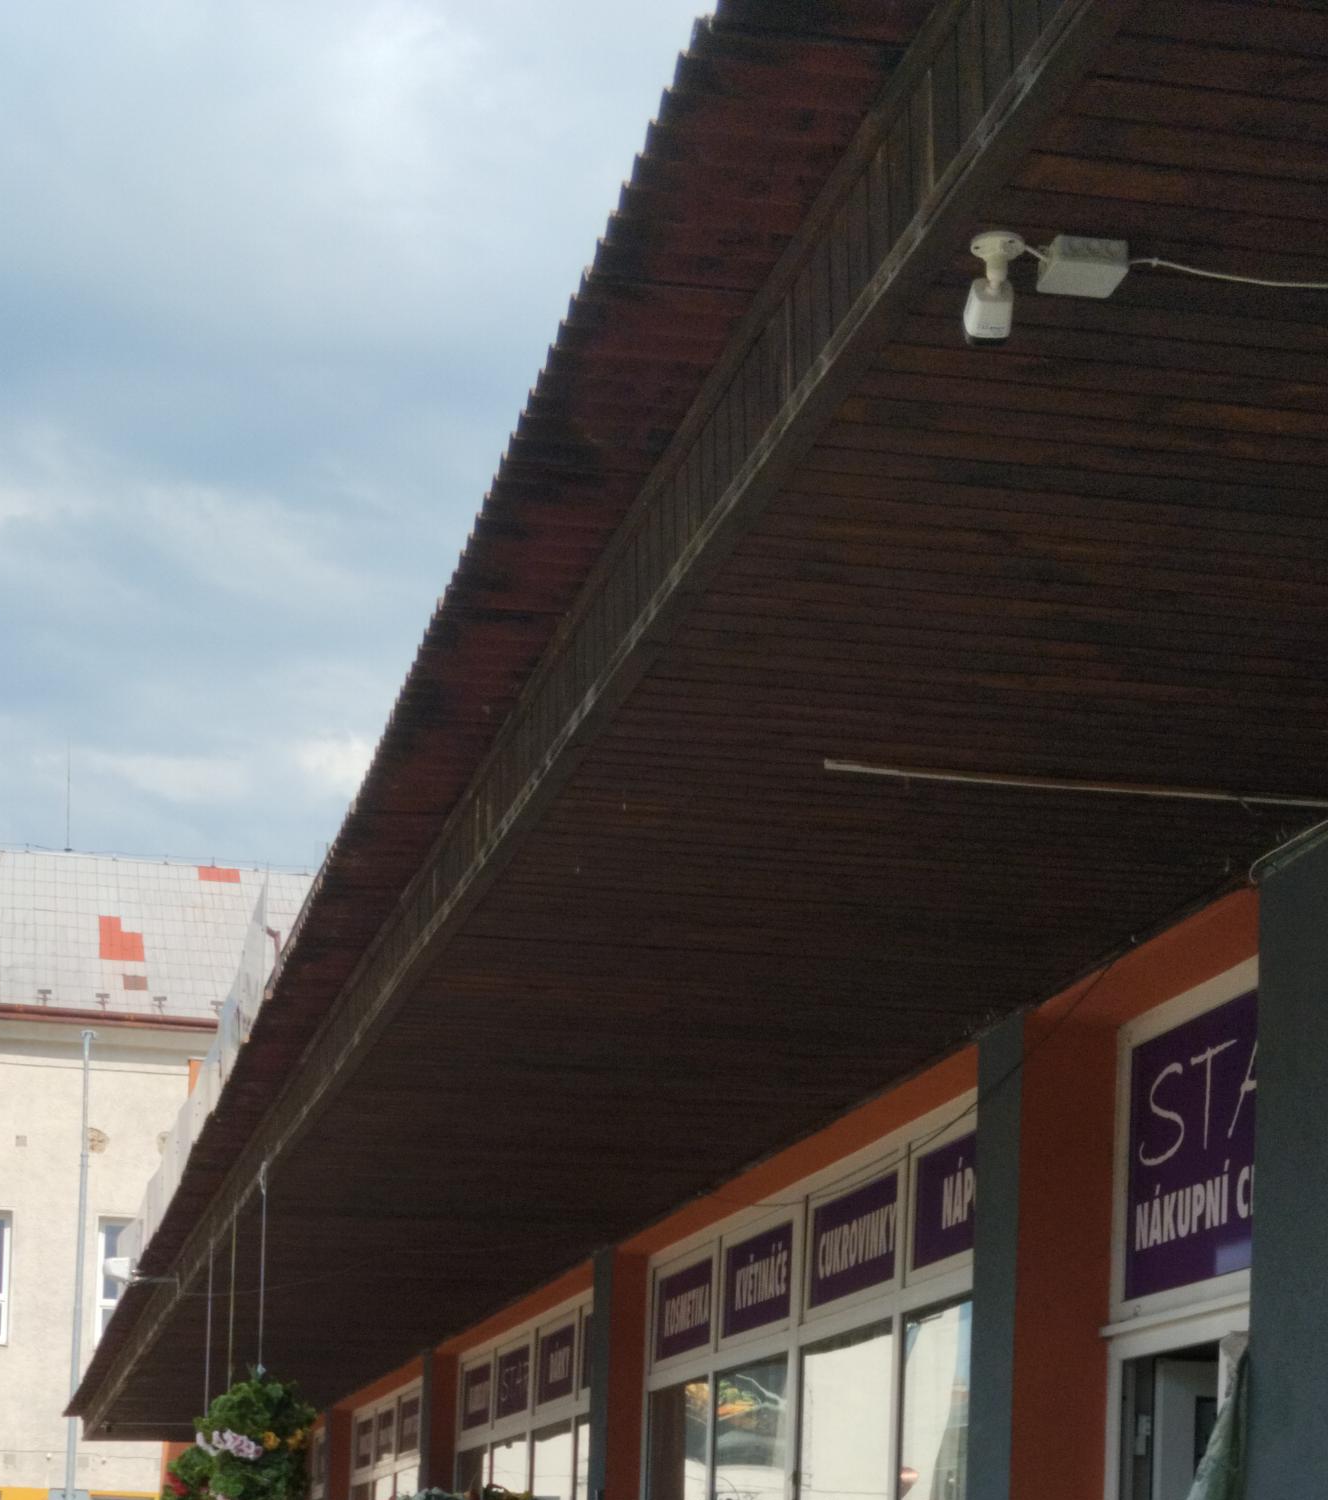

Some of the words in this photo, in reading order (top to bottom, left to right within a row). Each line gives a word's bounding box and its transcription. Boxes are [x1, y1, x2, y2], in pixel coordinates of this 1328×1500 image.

[941, 1156, 976, 1230] NÁP
[1134, 1159, 1230, 1252] NÁKUPNÍ
[1235, 1163, 1255, 1220] C
[734, 1241, 788, 1312] KVĚTINÁČE
[818, 1201, 898, 1280] CUKROVINKY
[664, 1283, 710, 1338] KOSMETIKA
